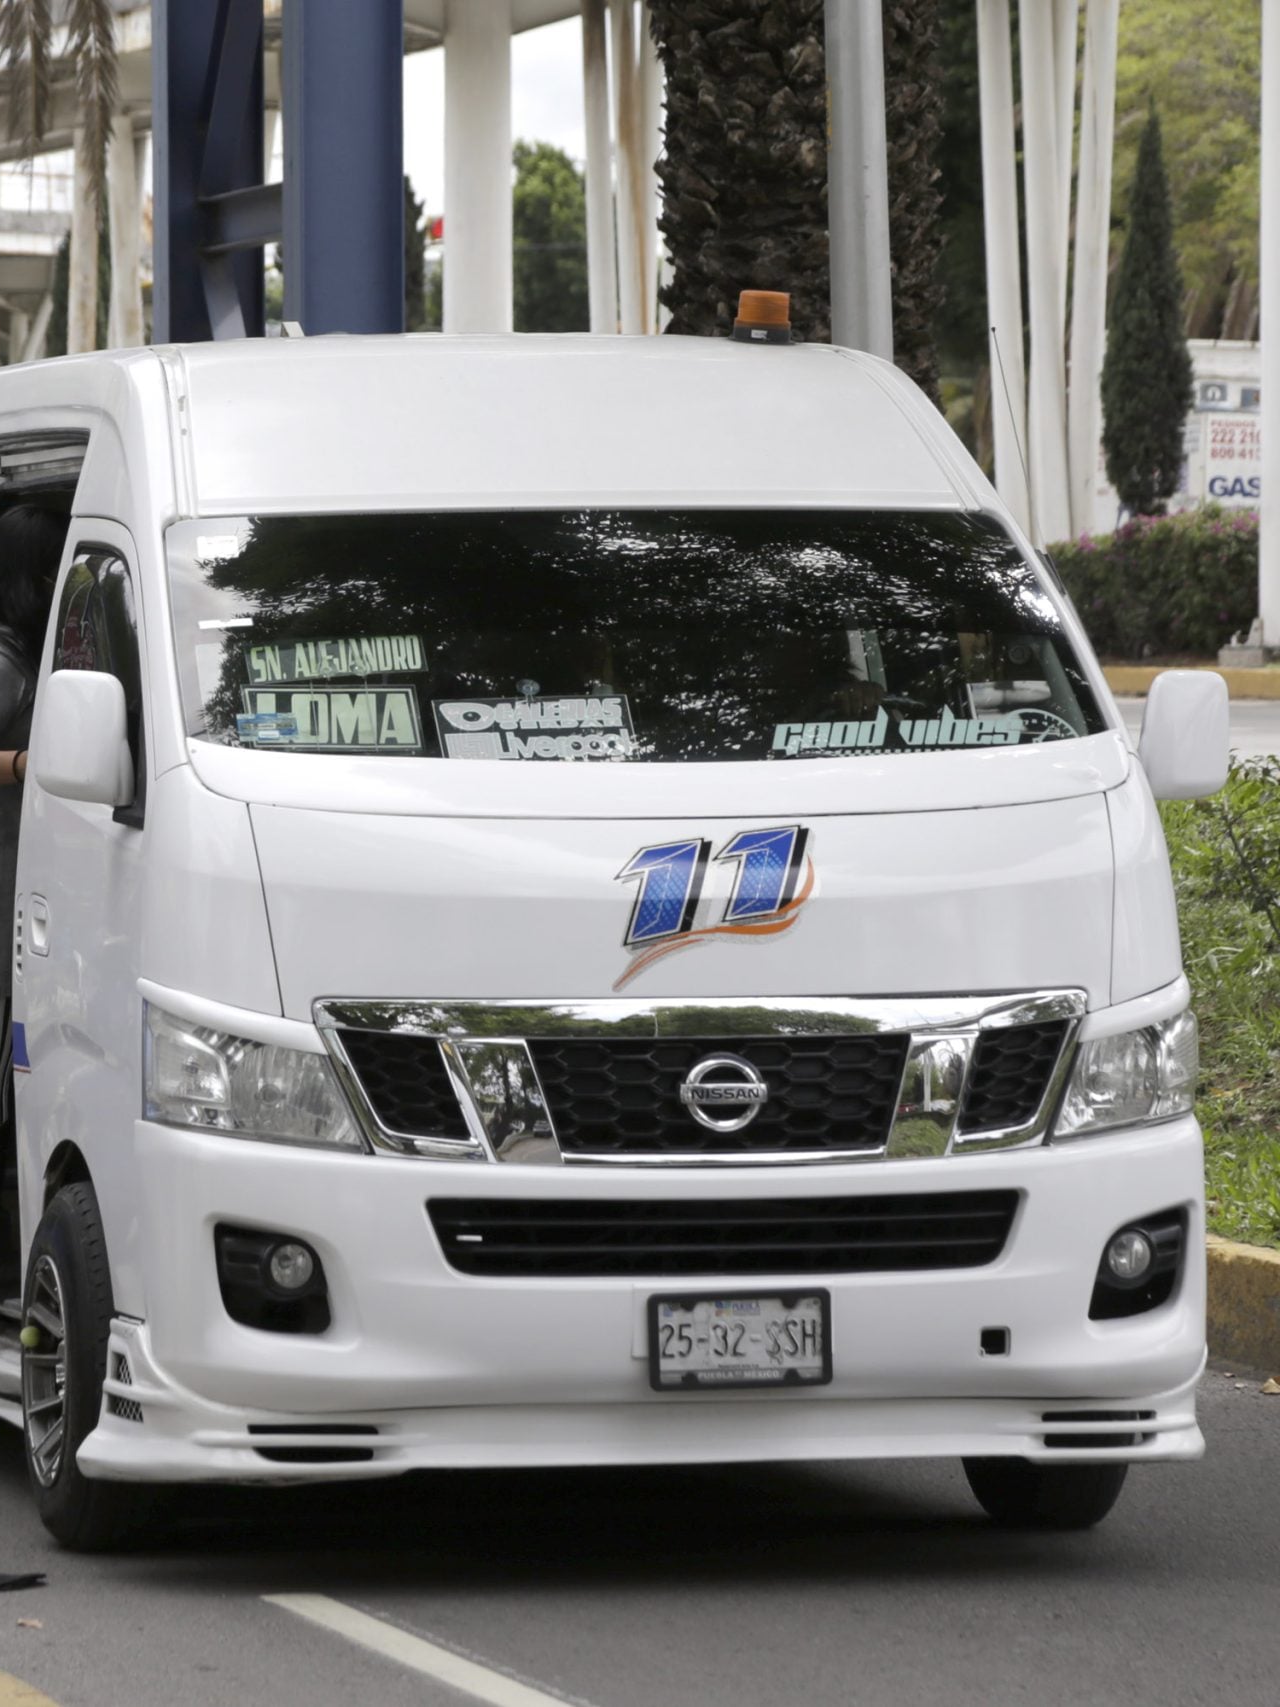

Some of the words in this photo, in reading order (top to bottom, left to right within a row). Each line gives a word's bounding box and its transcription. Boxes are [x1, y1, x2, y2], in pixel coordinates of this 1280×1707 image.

[1211, 429, 1235, 444] 222
[1208, 475, 1261, 498] GAS
[250, 645, 287, 683] SN.
[294, 634, 422, 679] ALEJANDRO
[613, 825, 810, 946] 11
[691, 1088, 759, 1100] NISSAN
